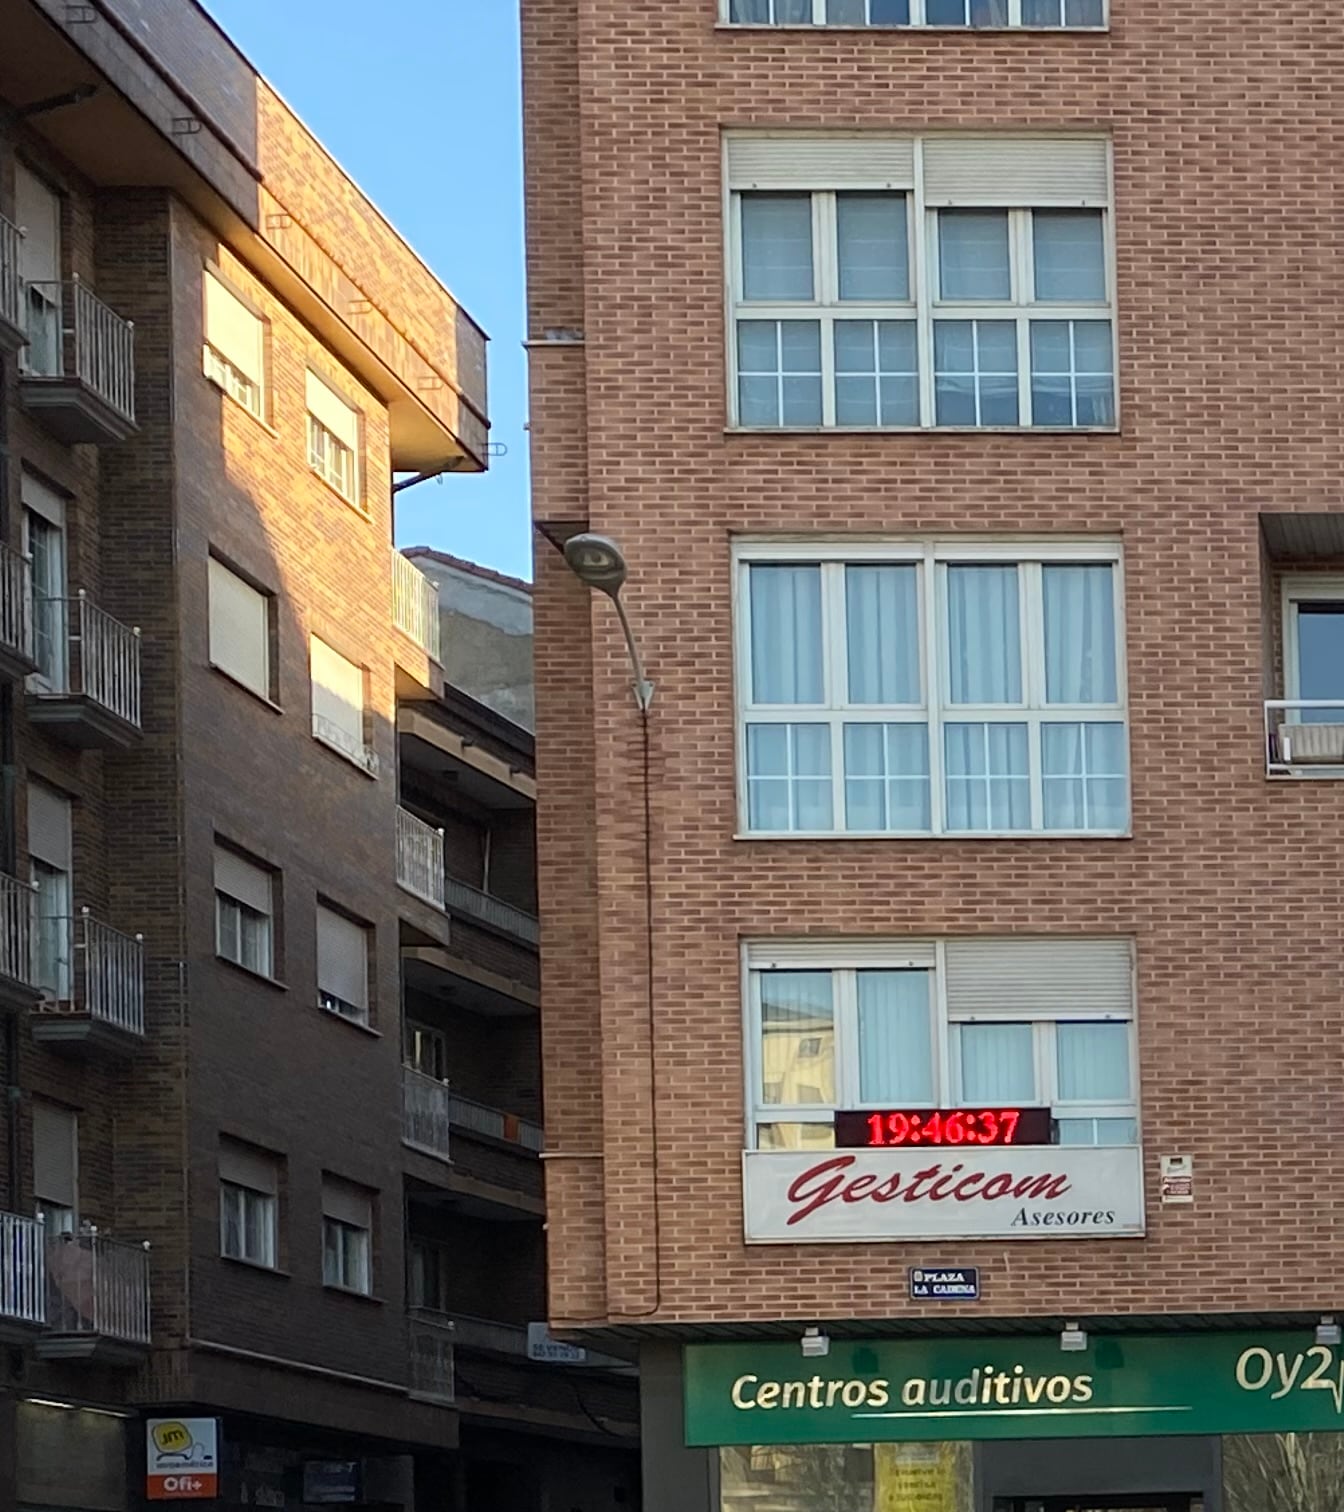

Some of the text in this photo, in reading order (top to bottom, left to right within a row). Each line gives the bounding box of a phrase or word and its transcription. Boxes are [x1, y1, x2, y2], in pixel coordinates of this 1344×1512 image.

[866, 1110, 1021, 1146] 19:46:37
[786, 1155, 1073, 1226] Gesticom
[1011, 1207, 1116, 1227] Asesores
[914, 1284, 928, 1294] LA
[924, 1272, 965, 1282] PLAZA
[731, 1364, 1094, 1411] Centros auditivos
[1235, 1344, 1335, 1399] Oy2
